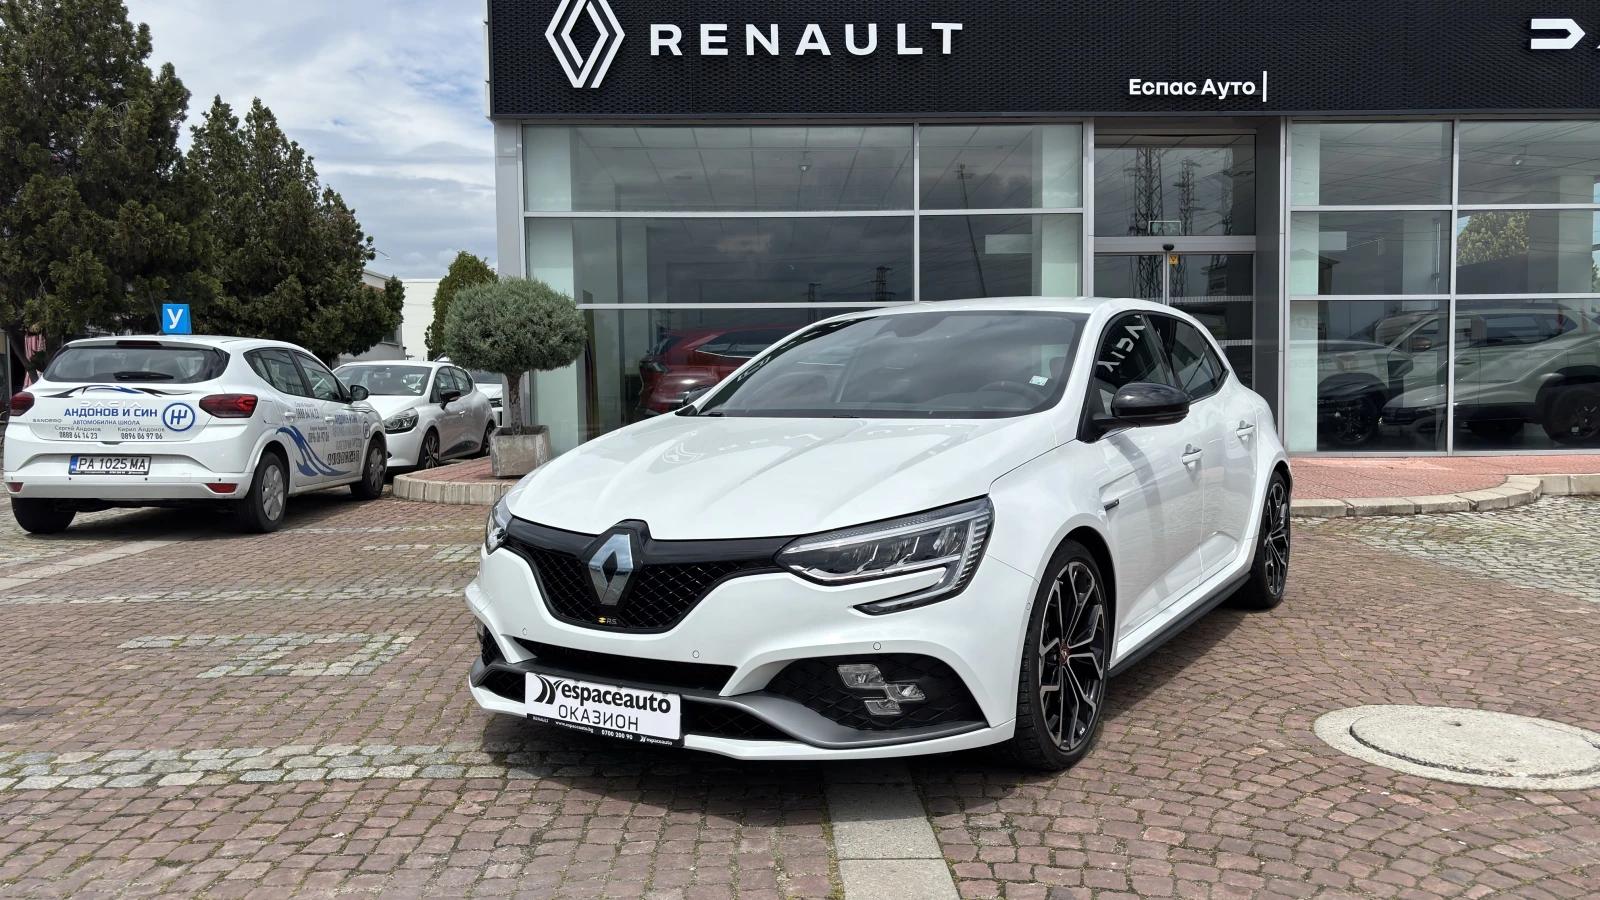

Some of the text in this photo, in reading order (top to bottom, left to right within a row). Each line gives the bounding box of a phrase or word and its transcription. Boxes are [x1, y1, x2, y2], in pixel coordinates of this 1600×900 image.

[650, 22, 964, 56] RENAULT
[1129, 78, 1256, 99] Еспас Ауто
[166, 308, 184, 330] У
[80, 400, 142, 408] DACIA
[64, 408, 158, 418] АНДОНОВ И СИН
[90, 432, 98, 440] 23
[120, 432, 136, 440] 0896
[146, 432, 154, 440] 97
[78, 458, 146, 470] PA 1025 MA
[561, 682, 672, 714] espaceauto
[558, 704, 639, 732] ОКАЗИОН
[555, 720, 594, 734] www.espaceauto.bg
[601, 729, 614, 737] 0700
[615, 731, 626, 739] 200
[646, 737, 673, 746] espaceauto
